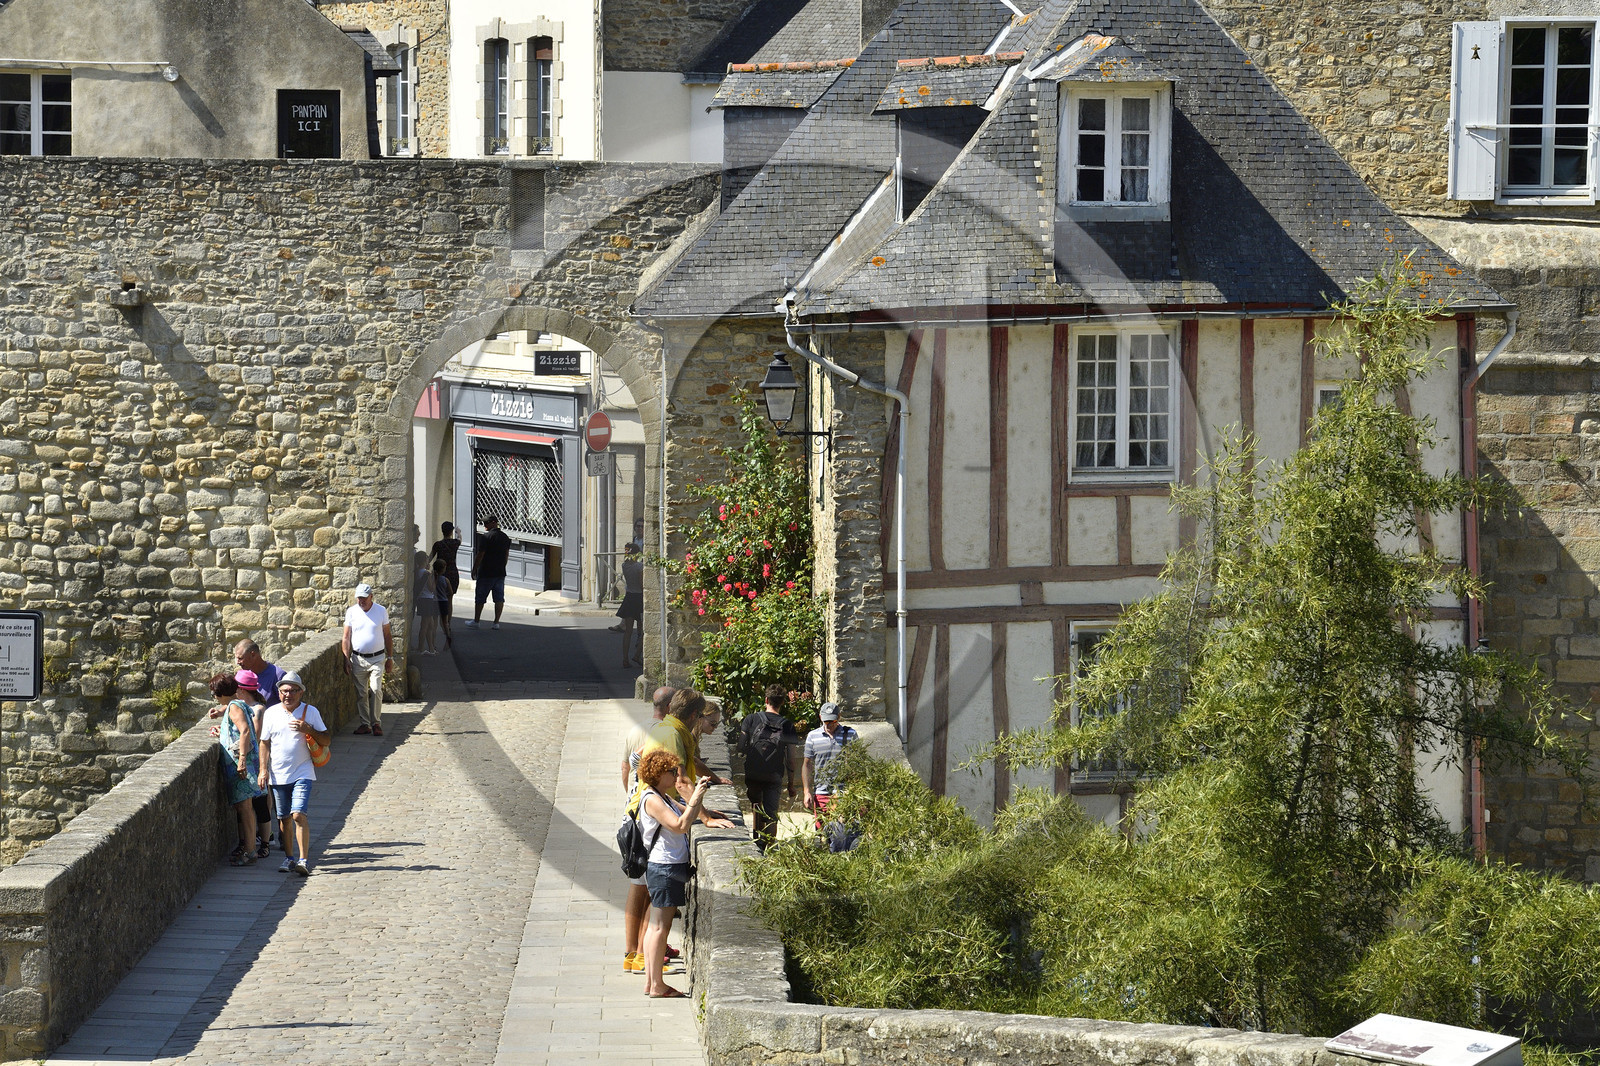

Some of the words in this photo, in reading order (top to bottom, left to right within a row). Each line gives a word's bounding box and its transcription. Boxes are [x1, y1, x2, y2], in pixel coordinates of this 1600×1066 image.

[292, 104, 327, 118] PANPAN
[298, 121, 320, 131] ICI
[539, 355, 577, 365] Zizzie
[491, 393, 534, 419] Zizzie
[594, 454, 605, 462] SAUF
